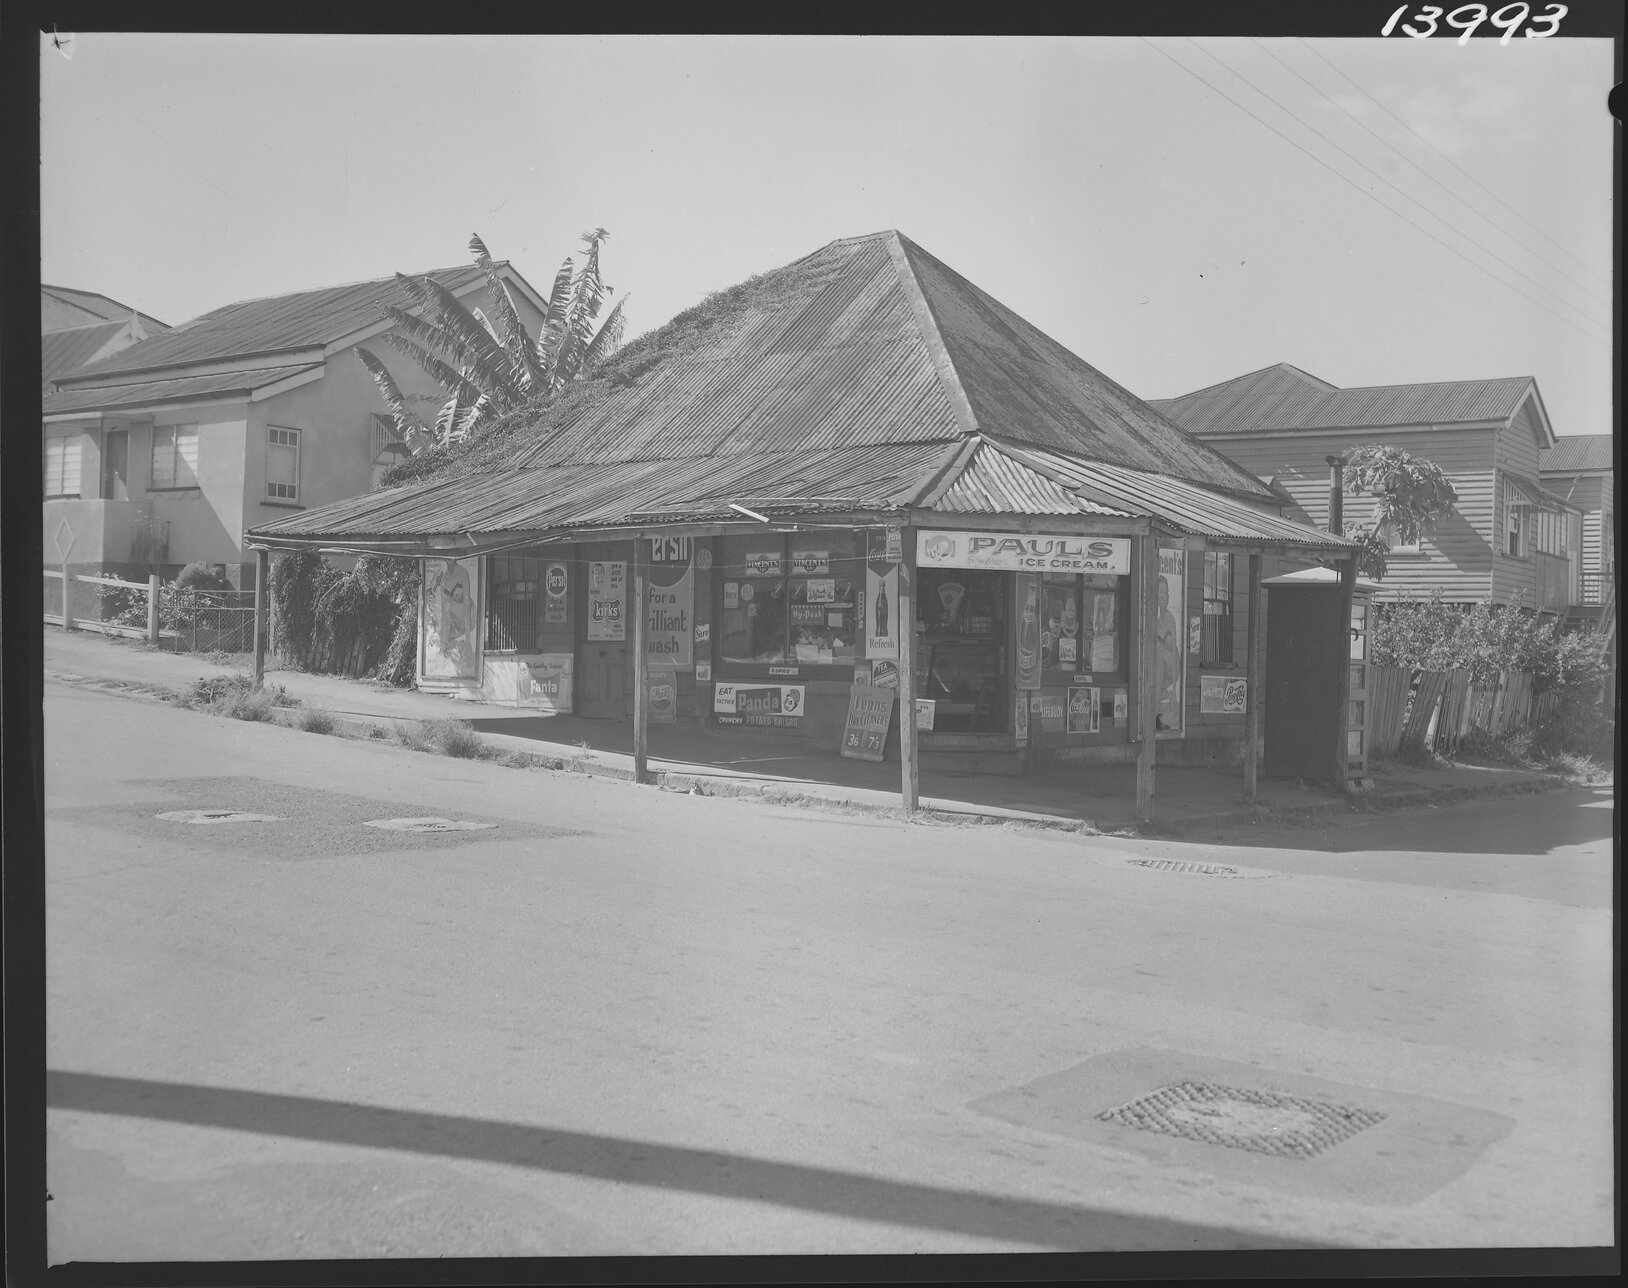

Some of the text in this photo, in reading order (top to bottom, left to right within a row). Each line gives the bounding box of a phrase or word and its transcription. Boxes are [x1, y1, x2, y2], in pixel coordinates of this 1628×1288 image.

[652, 537, 688, 561] ersil
[967, 537, 1114, 560] PAULS
[1020, 558, 1116, 570] ICE CREAM.
[649, 587, 677, 604] for a
[869, 638, 896, 649] Refresh
[530, 679, 558, 695] Fanta
[718, 687, 734, 696] EAT
[738, 691, 780, 711] Panda
[746, 715, 772, 727] POTATO
